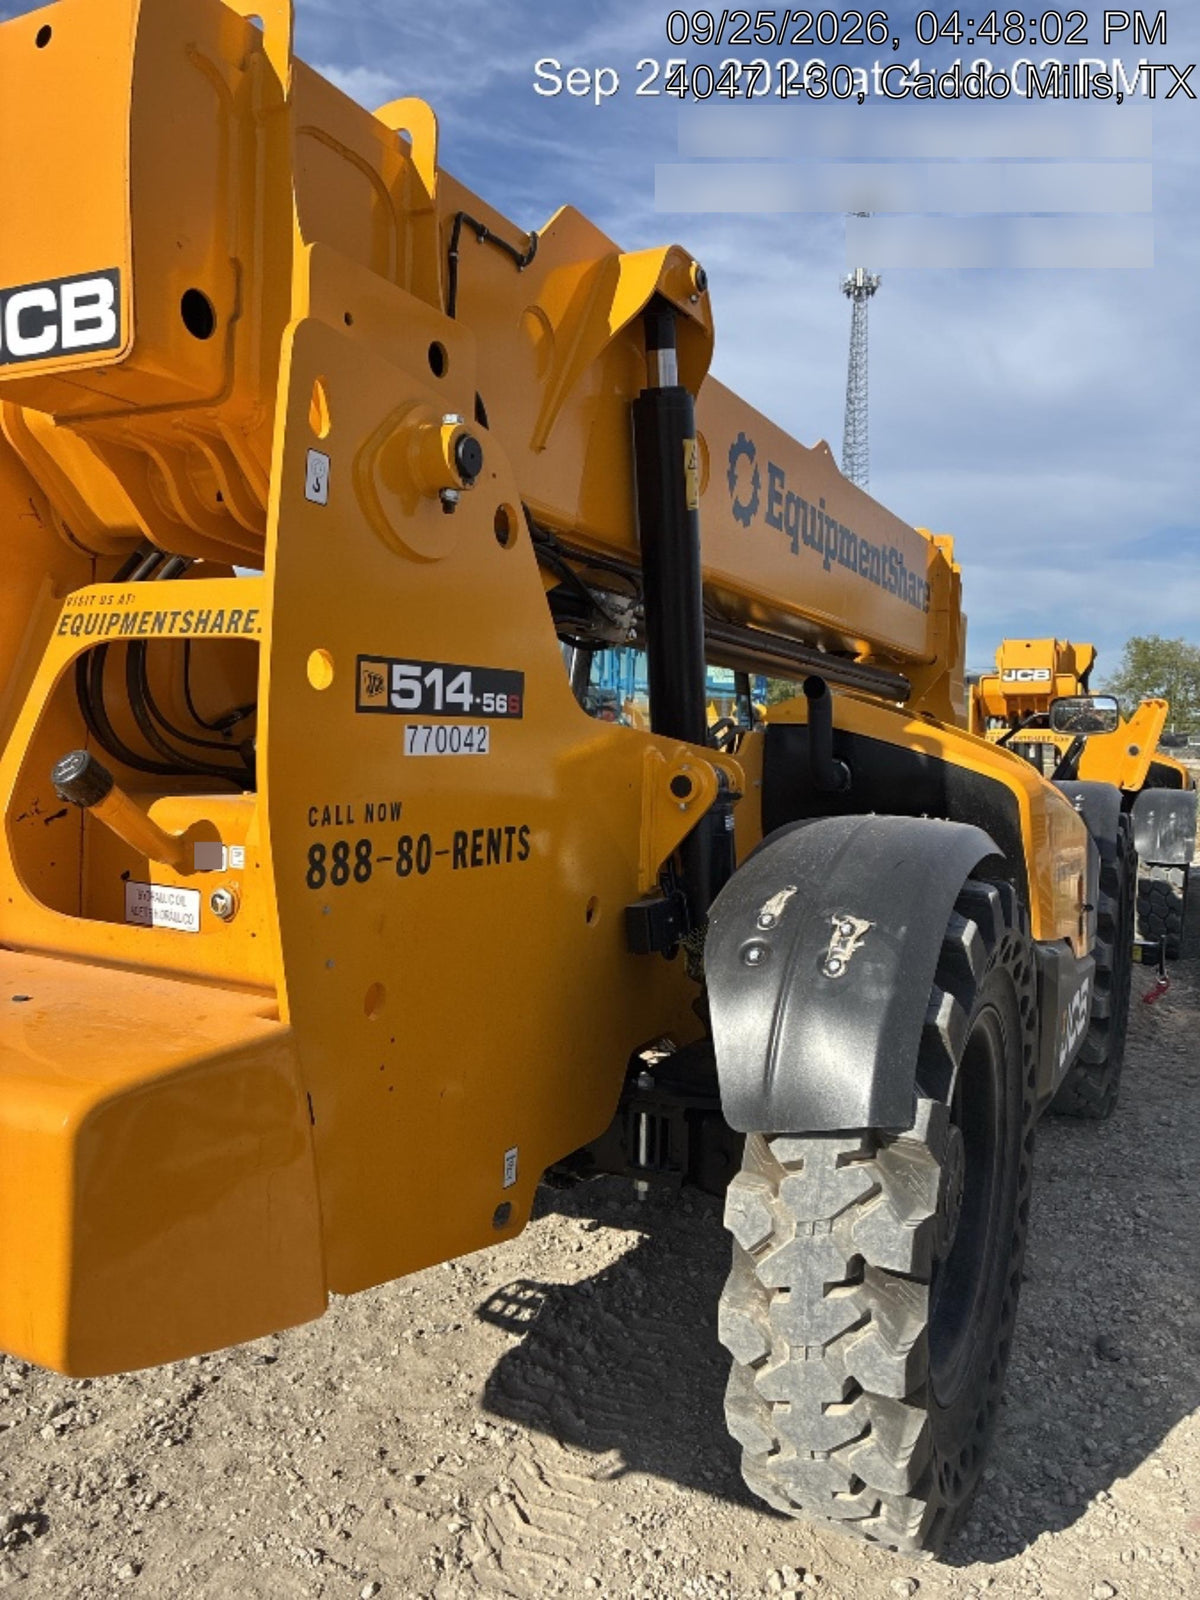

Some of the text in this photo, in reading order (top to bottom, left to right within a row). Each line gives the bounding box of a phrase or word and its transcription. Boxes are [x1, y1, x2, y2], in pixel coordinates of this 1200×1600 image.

[0, 278, 116, 357] CB
[66, 595, 96, 607] VISIT
[99, 594, 114, 605] US
[1002, 669, 1050, 681] JCB
[407, 726, 487, 753] 770042
[308, 801, 402, 827] CALL NOW
[306, 824, 531, 890] 888-80-RENTS
